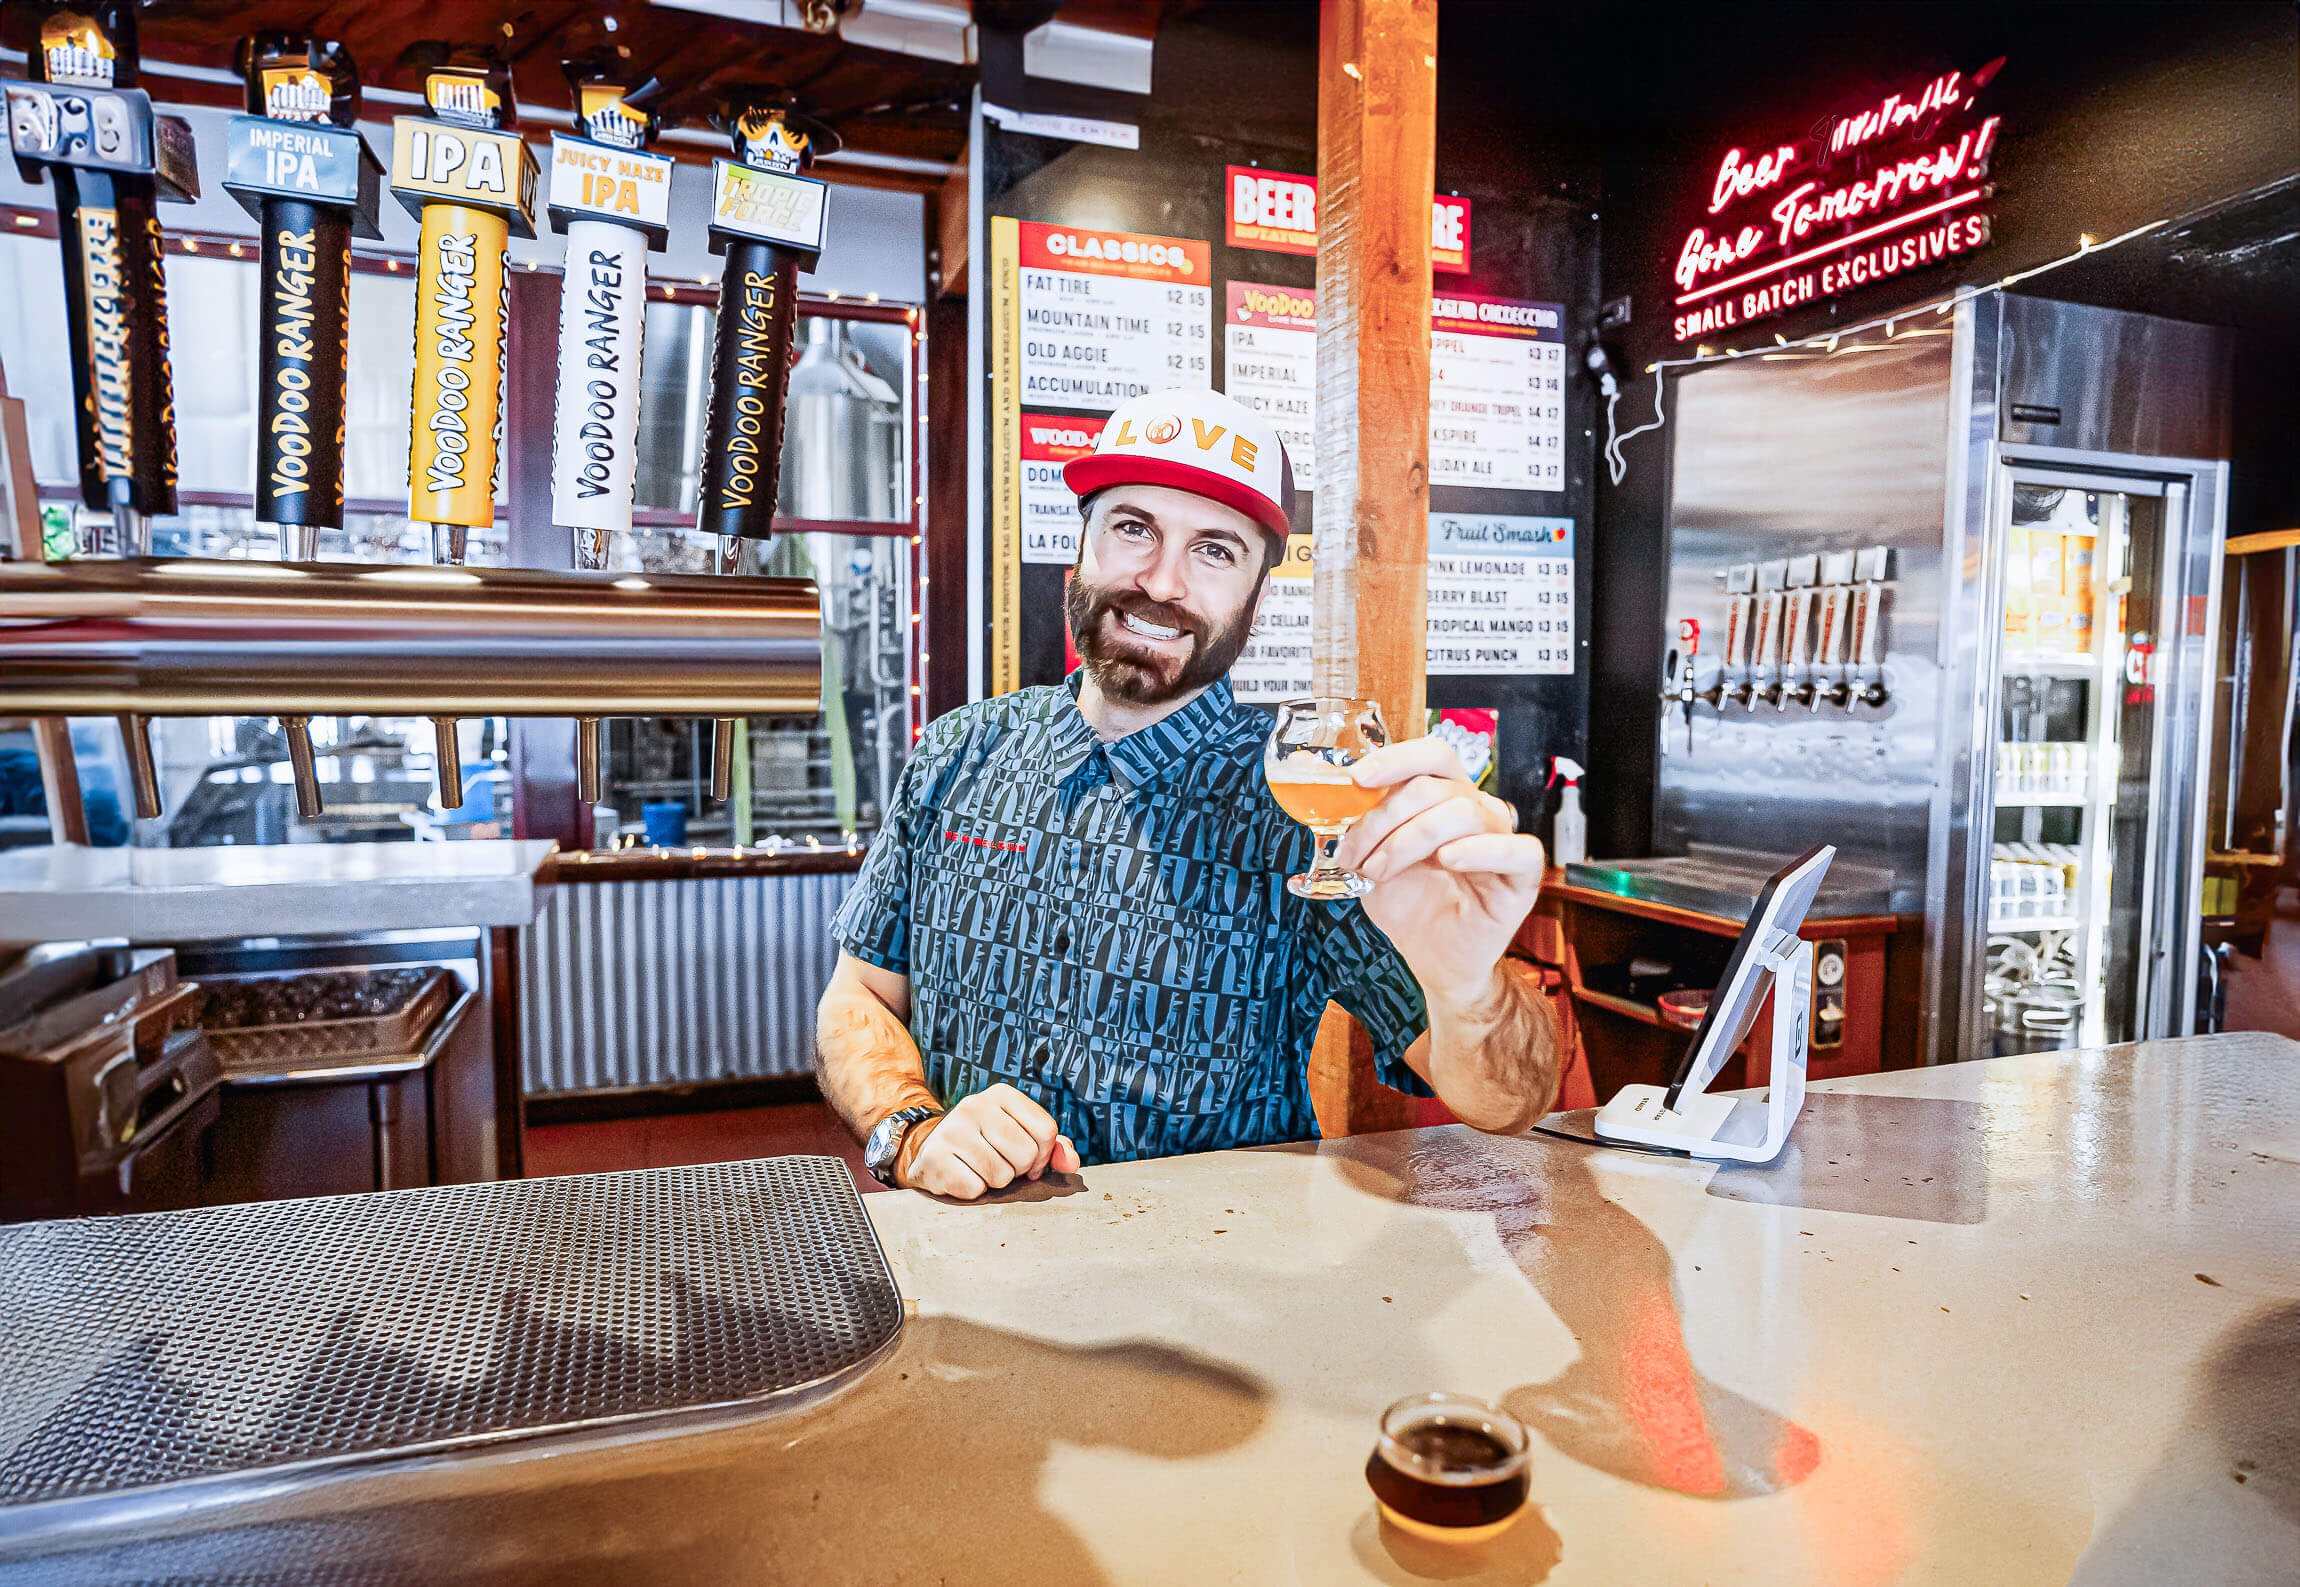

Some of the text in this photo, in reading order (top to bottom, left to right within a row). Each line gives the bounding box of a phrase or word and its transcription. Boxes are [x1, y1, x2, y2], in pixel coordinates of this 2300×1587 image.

[250, 128, 334, 158] IMPERIAL
[411, 131, 505, 192] IPA
[266, 150, 320, 191] IPA
[557, 148, 665, 184] JUICY HAZE
[1708, 146, 1795, 214] Beer
[582, 173, 640, 215] IPA
[1234, 174, 1316, 232] BEER
[1432, 203, 1463, 250] RE
[1046, 233, 1185, 267] CLASSICS
[1027, 275, 1092, 295] FAT TIRE
[1674, 214, 1983, 343] SMALL BATCH EXCLUSIVES
[1027, 308, 1150, 334] MOUNTAIN TIME
[273, 228, 315, 498] VOODOO RANGER
[428, 233, 477, 493] VOODOO RANGER
[1027, 342, 1109, 363] OLD AGGIE
[577, 250, 623, 499] VOODOO RANGER
[723, 270, 777, 510] VOODOO RANGER
[1027, 375, 1150, 398] ACCUMULATION
[1116, 414, 1258, 473] LOVE
[1029, 534, 1078, 549] LA FOL
[1442, 519, 1552, 543] Fruit Smash
[1460, 561, 1525, 575] LEMONADE
[1471, 590, 1507, 603] BLAST
